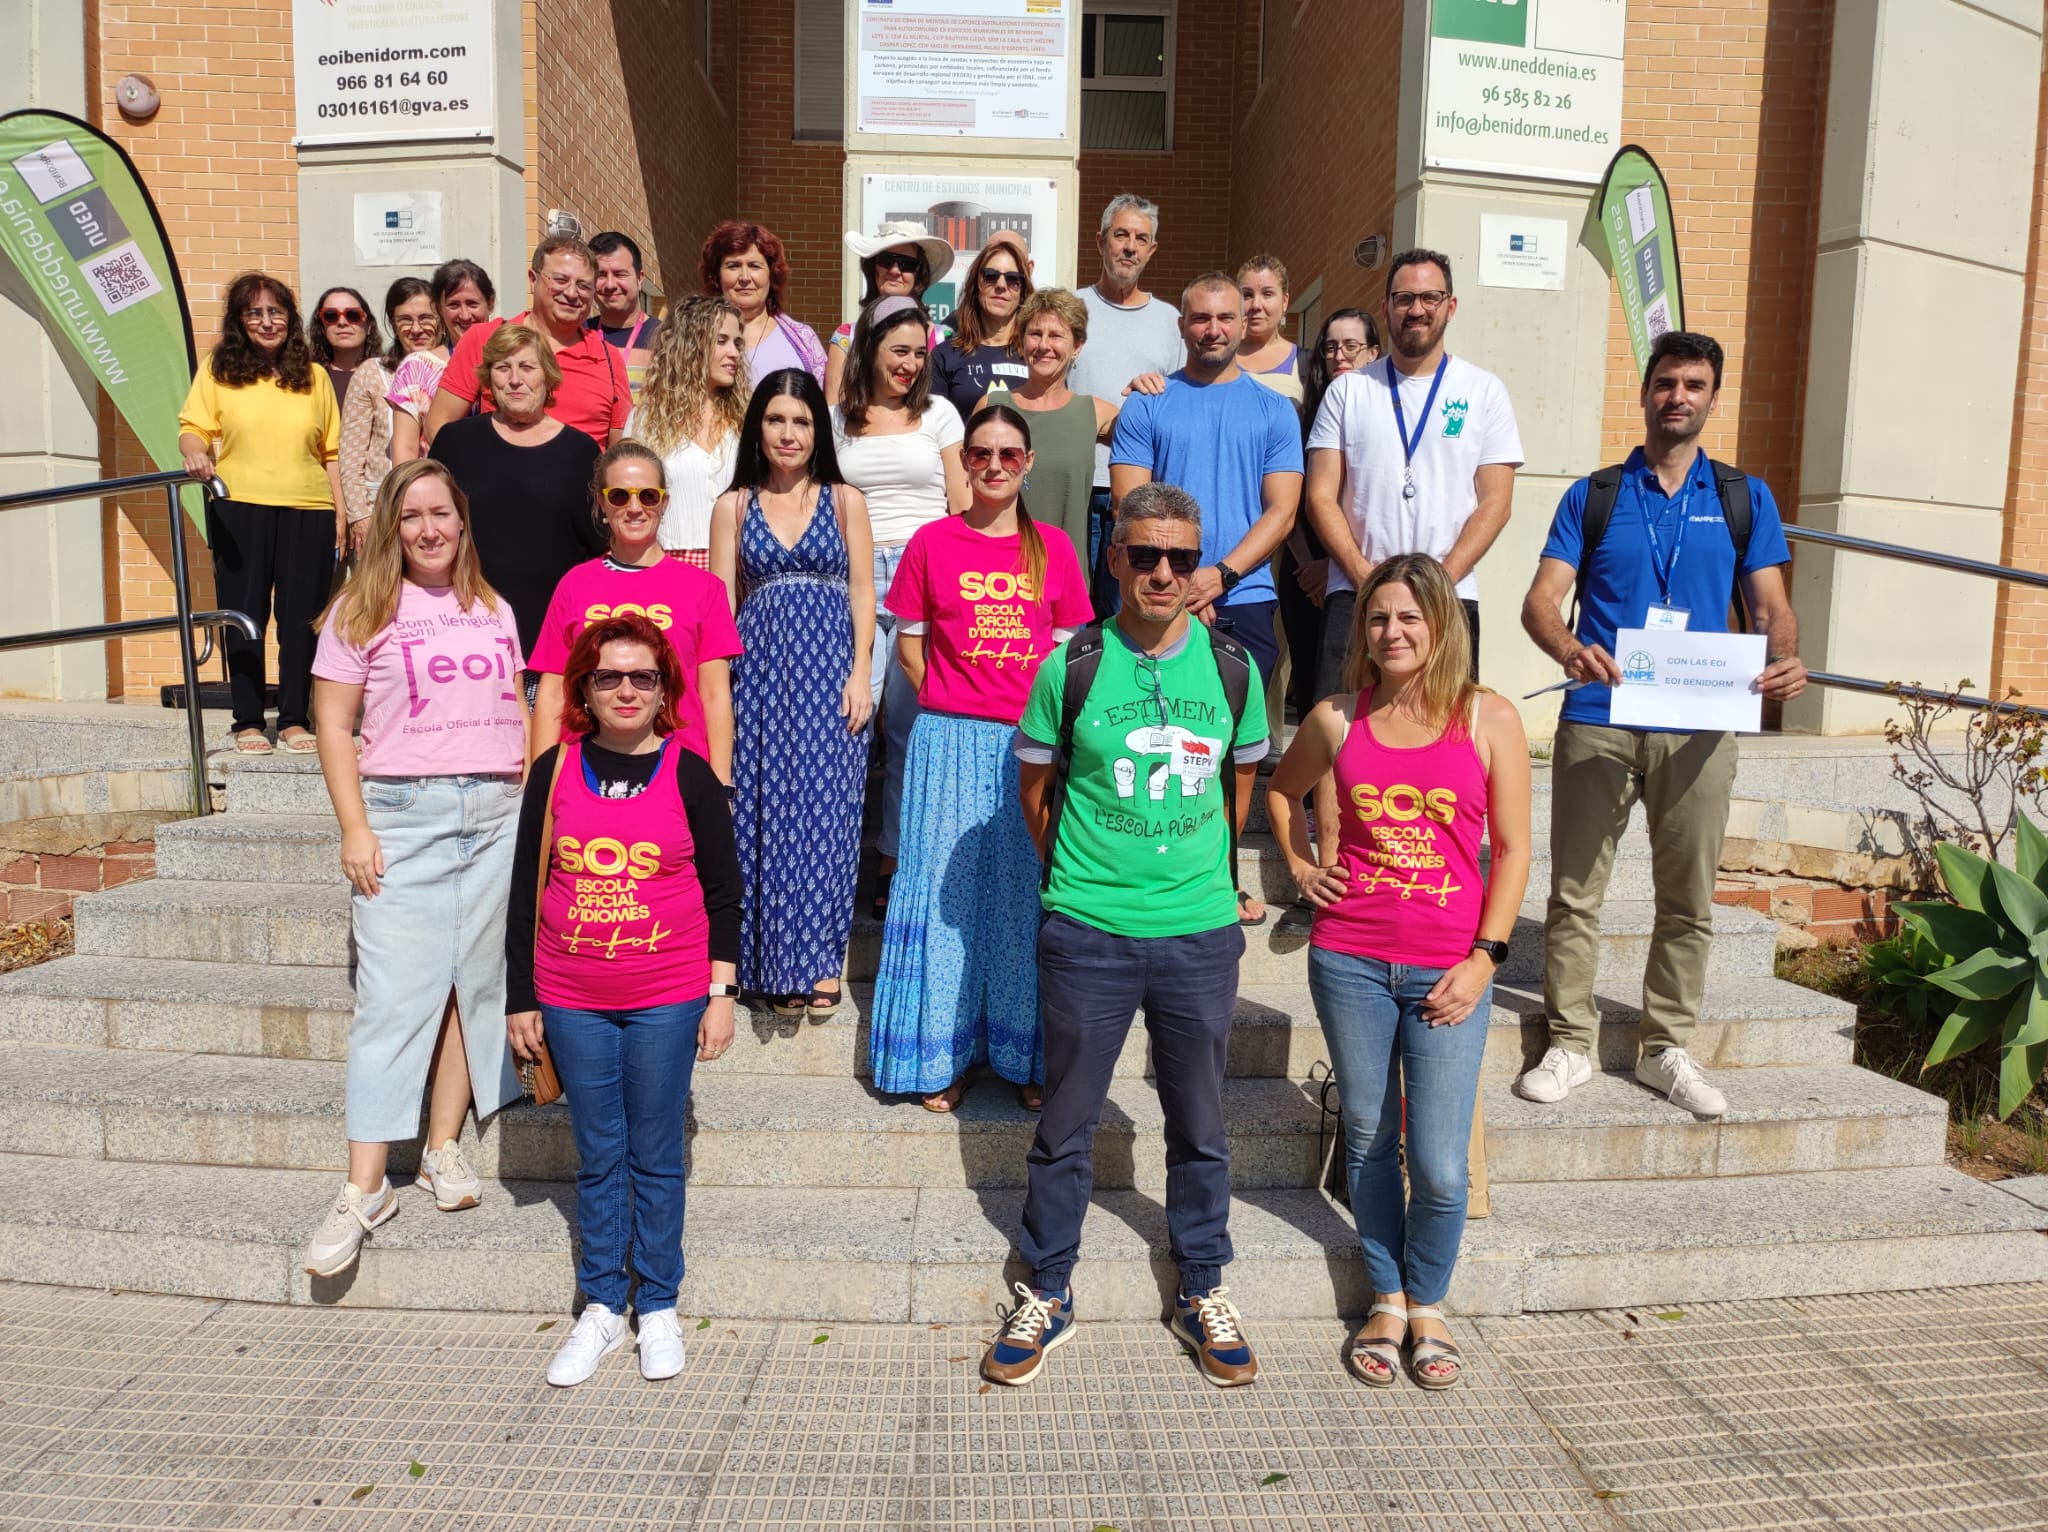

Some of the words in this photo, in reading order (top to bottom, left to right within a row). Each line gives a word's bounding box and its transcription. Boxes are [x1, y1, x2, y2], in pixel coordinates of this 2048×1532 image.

[318, 45, 467, 66] eoibenidorm.com
[1458, 52, 1597, 81] www.uneddenia.es
[337, 75, 367, 90] 966
[374, 73, 393, 88] 81
[400, 72, 421, 87] 64
[427, 70, 448, 85] 60
[1482, 85, 1499, 104] 96
[1503, 88, 1529, 109] 585
[1534, 90, 1550, 107] 82
[1555, 93, 1572, 109] 26
[317, 98, 469, 118] 03016161@gva.es
[1436, 110, 1609, 145] info@benidorm.uned.es
[884, 180, 920, 193] CENTRO
[922, 181, 934, 194] DE
[936, 181, 980, 195] ESTUDIOS
[985, 182, 1033, 196] MUNICIPAL
[959, 571, 1035, 601] SOS
[974, 604, 1025, 616] ESCOLA
[396, 617, 434, 630] Som
[975, 616, 1025, 627] OFICIAL
[968, 627, 1031, 639] D'IDIOMES
[1666, 657, 1688, 665] CON
[1690, 658, 1708, 666] LAS
[1710, 659, 1727, 667] EOI
[1622, 670, 1655, 681] ANPE
[1665, 677, 1681, 685] EOI
[1683, 678, 1734, 687] BENIDORM
[1104, 698, 1217, 727] ESTIMEM
[402, 721, 443, 734] Escola
[446, 718, 481, 729] Oficial
[1350, 783, 1458, 825] SOS
[1094, 807, 1164, 838] L'ESCOLA
[1371, 826, 1437, 841] ESCOLA
[1376, 840, 1436, 854] OFICIAL
[557, 836, 661, 880] SOS
[1368, 851, 1445, 869] D'IDIOMES
[575, 878, 639, 893] ESCOLA
[576, 892, 639, 908] OFICIAL
[567, 905, 650, 923] D'IDIOMES
